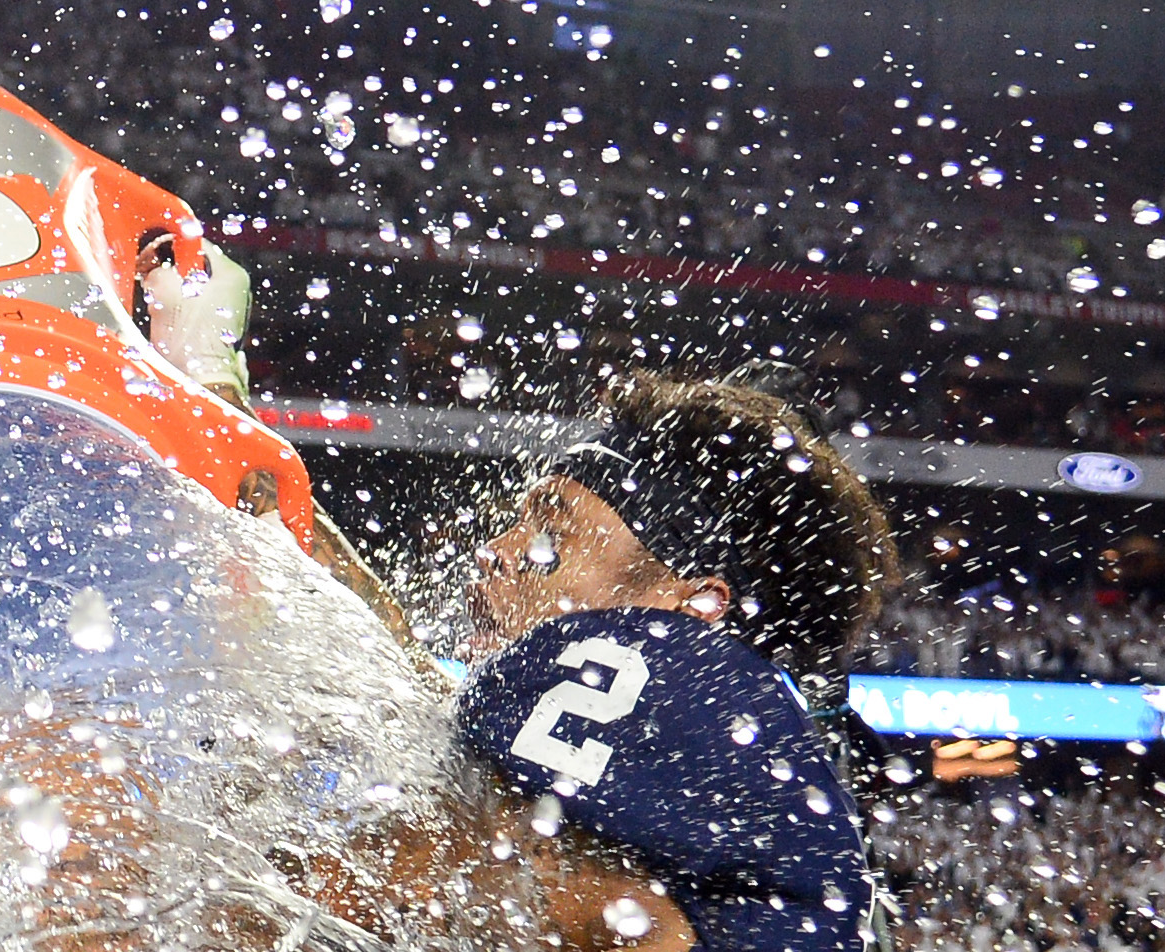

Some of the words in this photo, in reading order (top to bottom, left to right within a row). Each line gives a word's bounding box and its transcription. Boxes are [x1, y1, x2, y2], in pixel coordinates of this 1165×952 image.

[1072, 455, 1128, 487] Ford
[511, 637, 650, 787] 2
[902, 689, 1020, 732] BOWL
